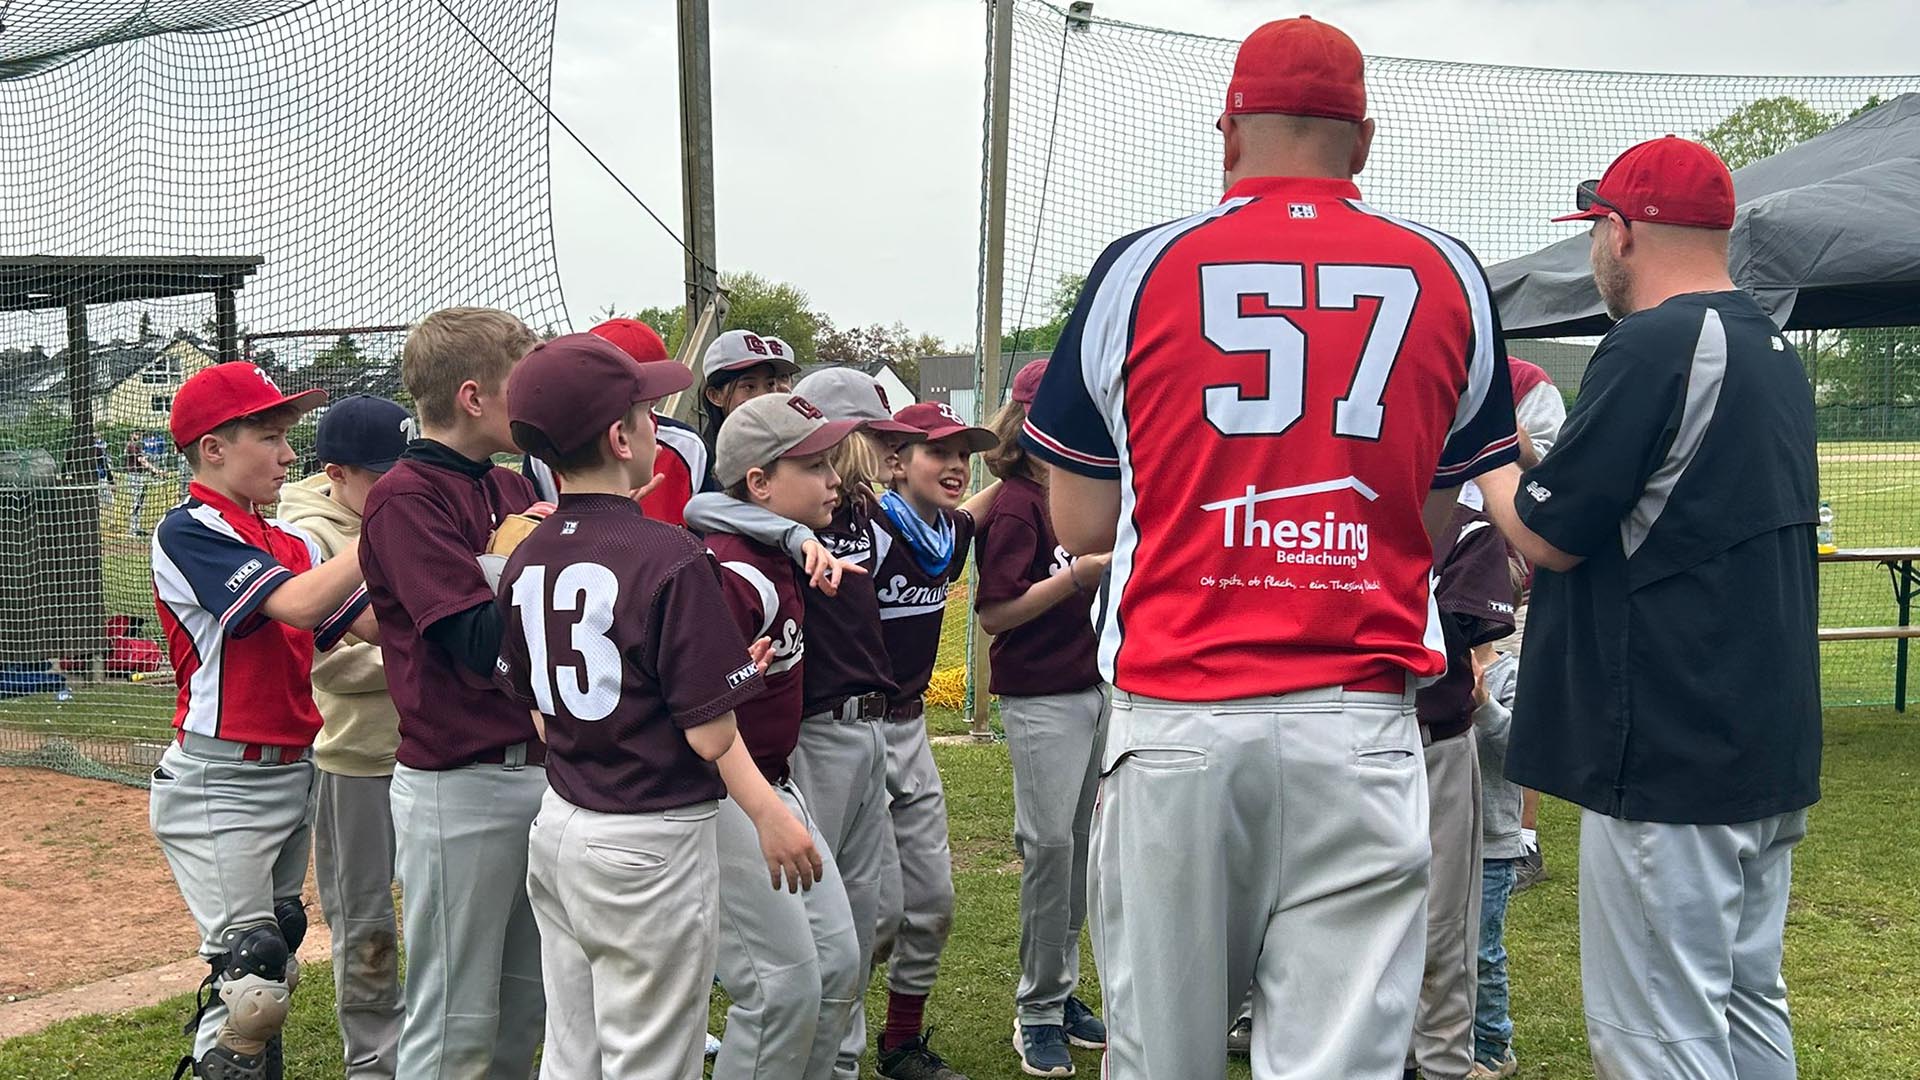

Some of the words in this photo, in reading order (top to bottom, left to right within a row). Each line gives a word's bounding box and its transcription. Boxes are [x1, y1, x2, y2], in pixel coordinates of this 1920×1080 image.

[1199, 263, 1418, 442] 57
[1206, 482, 1370, 561] Thesing
[1276, 550, 1358, 569] Bedachung
[1200, 576, 1215, 587] Ob
[1247, 576, 1261, 587] ob
[1309, 580, 1328, 589] ein
[1491, 602, 1514, 613] TNK
[511, 562, 623, 722] 13
[729, 662, 759, 684] TNK
